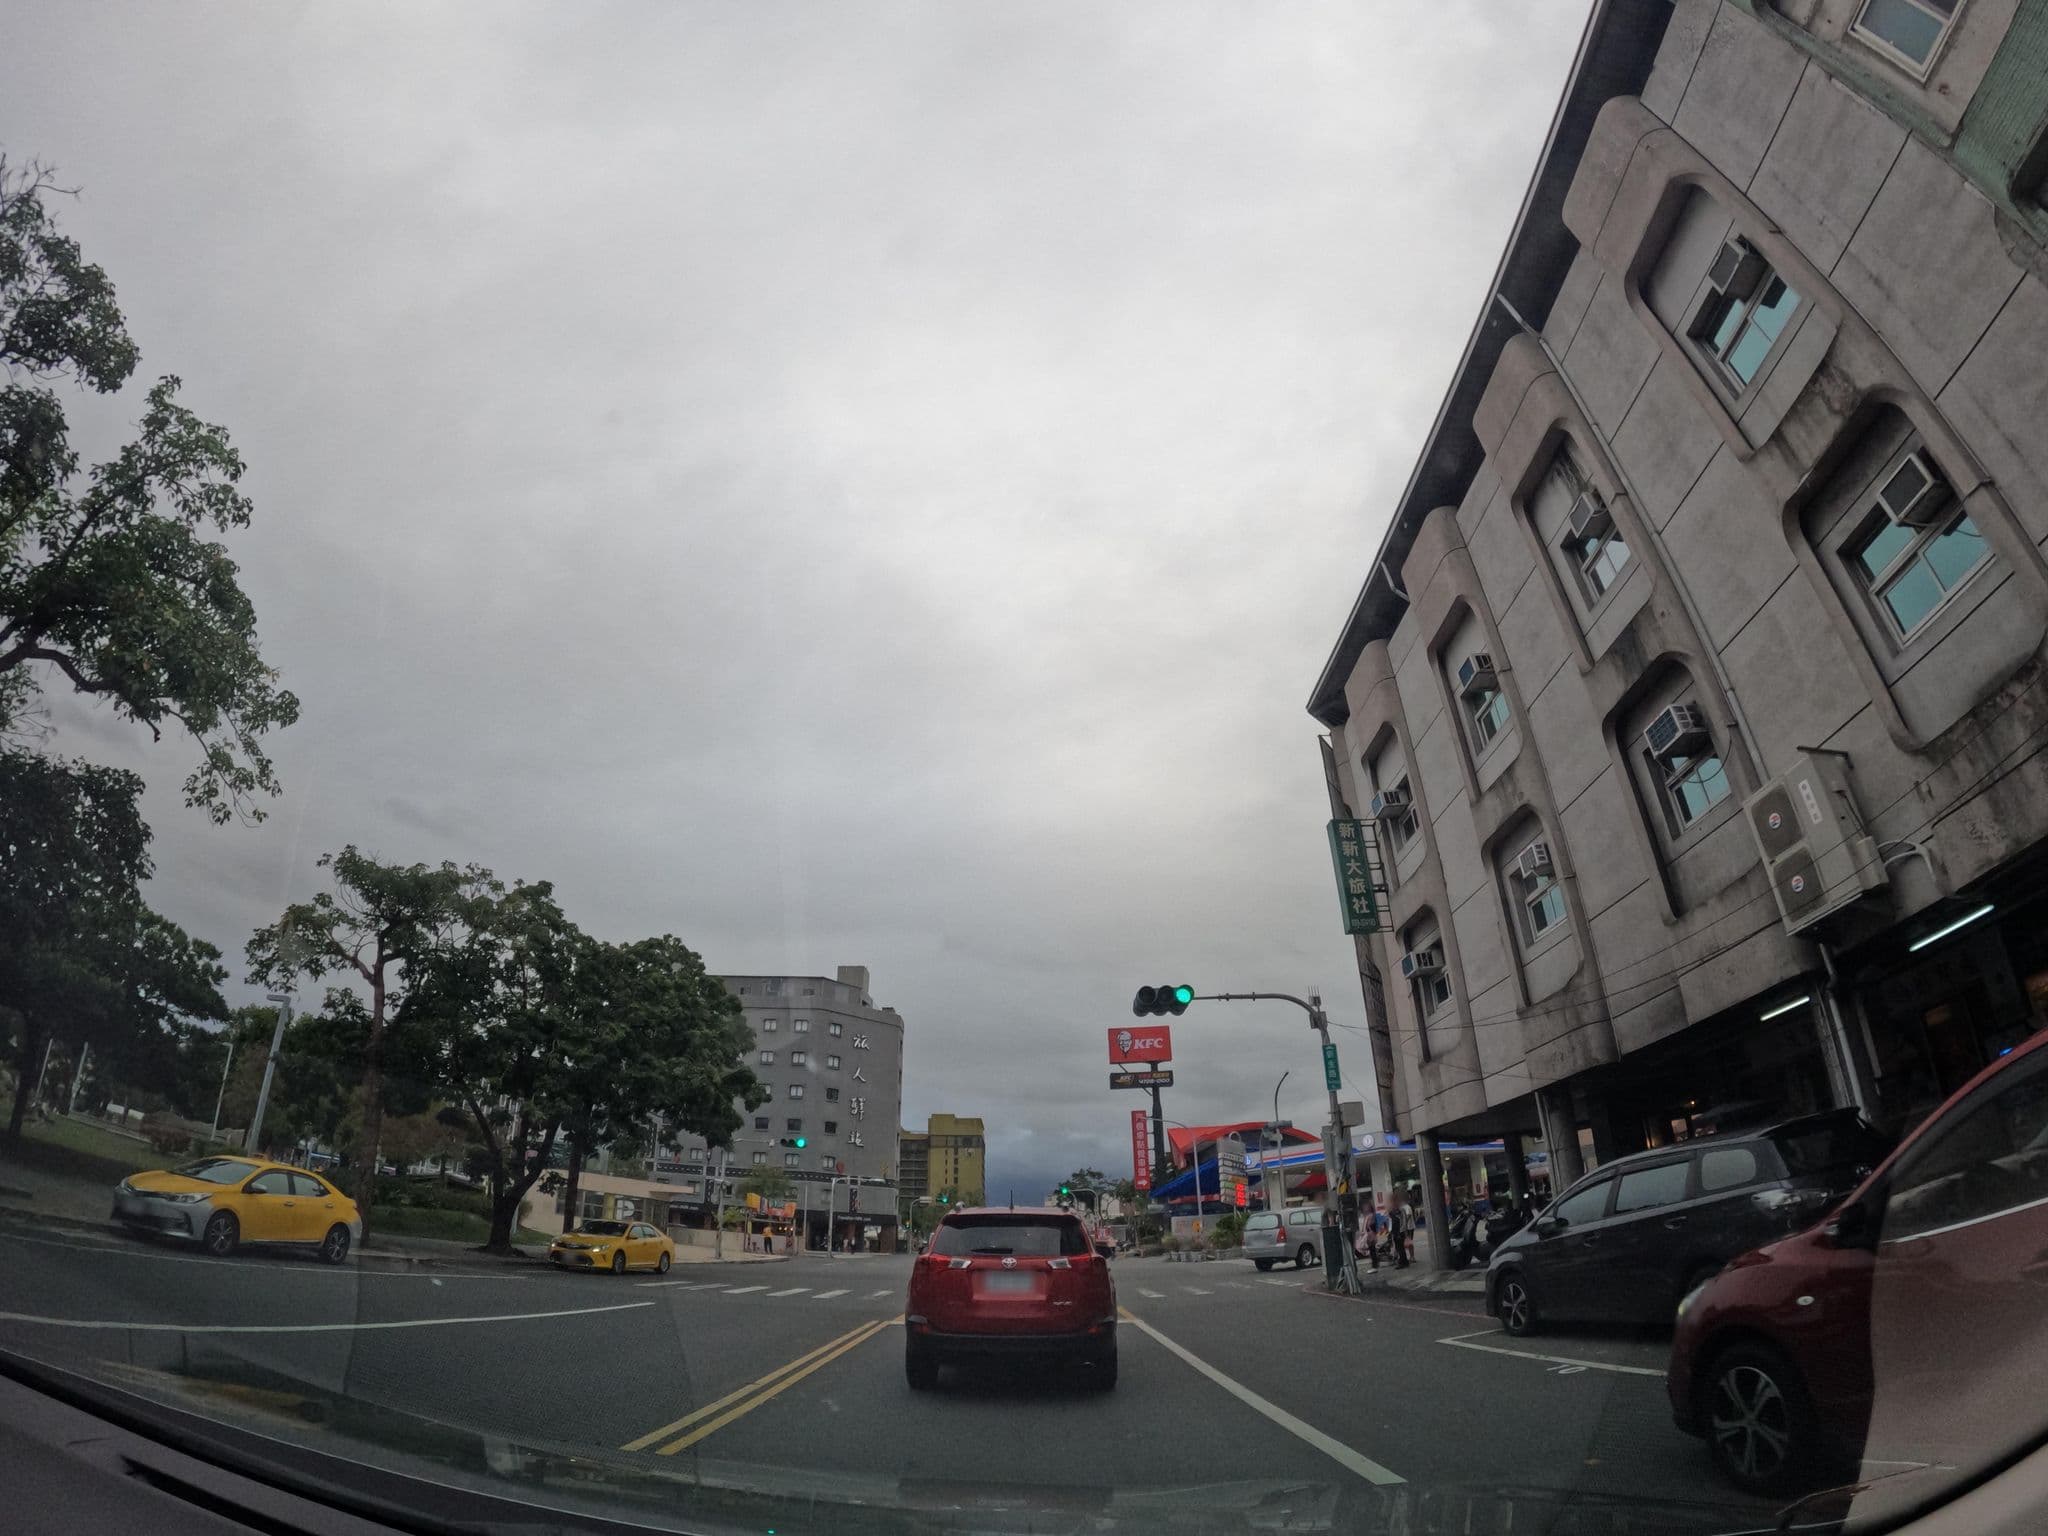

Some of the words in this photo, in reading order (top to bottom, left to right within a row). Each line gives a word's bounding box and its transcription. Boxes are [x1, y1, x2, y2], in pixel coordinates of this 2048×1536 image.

[1338, 822, 1370, 914] 新新大旅社
[1133, 1037, 1164, 1050] KFC
